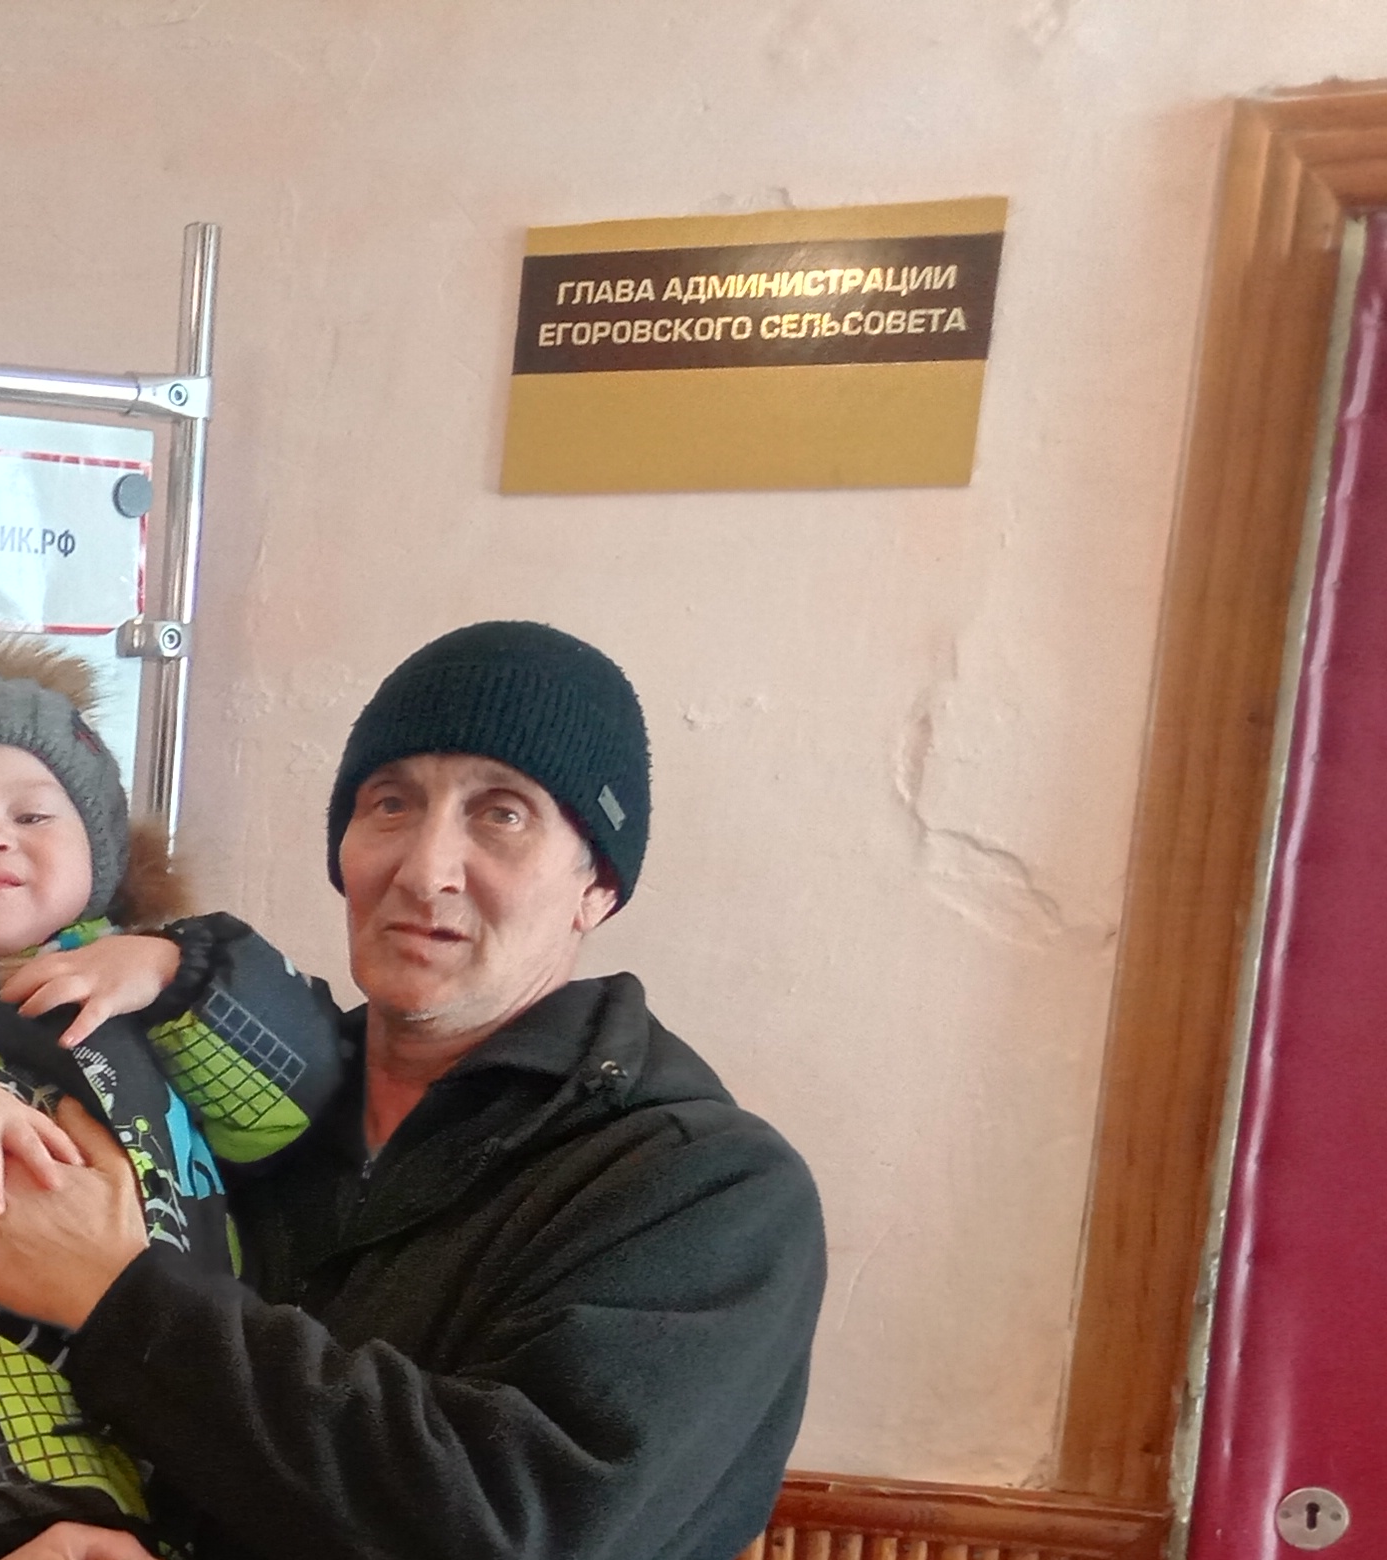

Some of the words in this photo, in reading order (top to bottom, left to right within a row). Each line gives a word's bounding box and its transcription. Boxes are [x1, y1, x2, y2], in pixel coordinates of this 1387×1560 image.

[556, 278, 656, 306] ГЛАВА
[661, 264, 958, 306] АДМИНИСТРАЦИИ
[538, 314, 753, 348] ЕГОРОВСКОГО
[759, 306, 968, 341] СЕЛЬСОВЕТА
